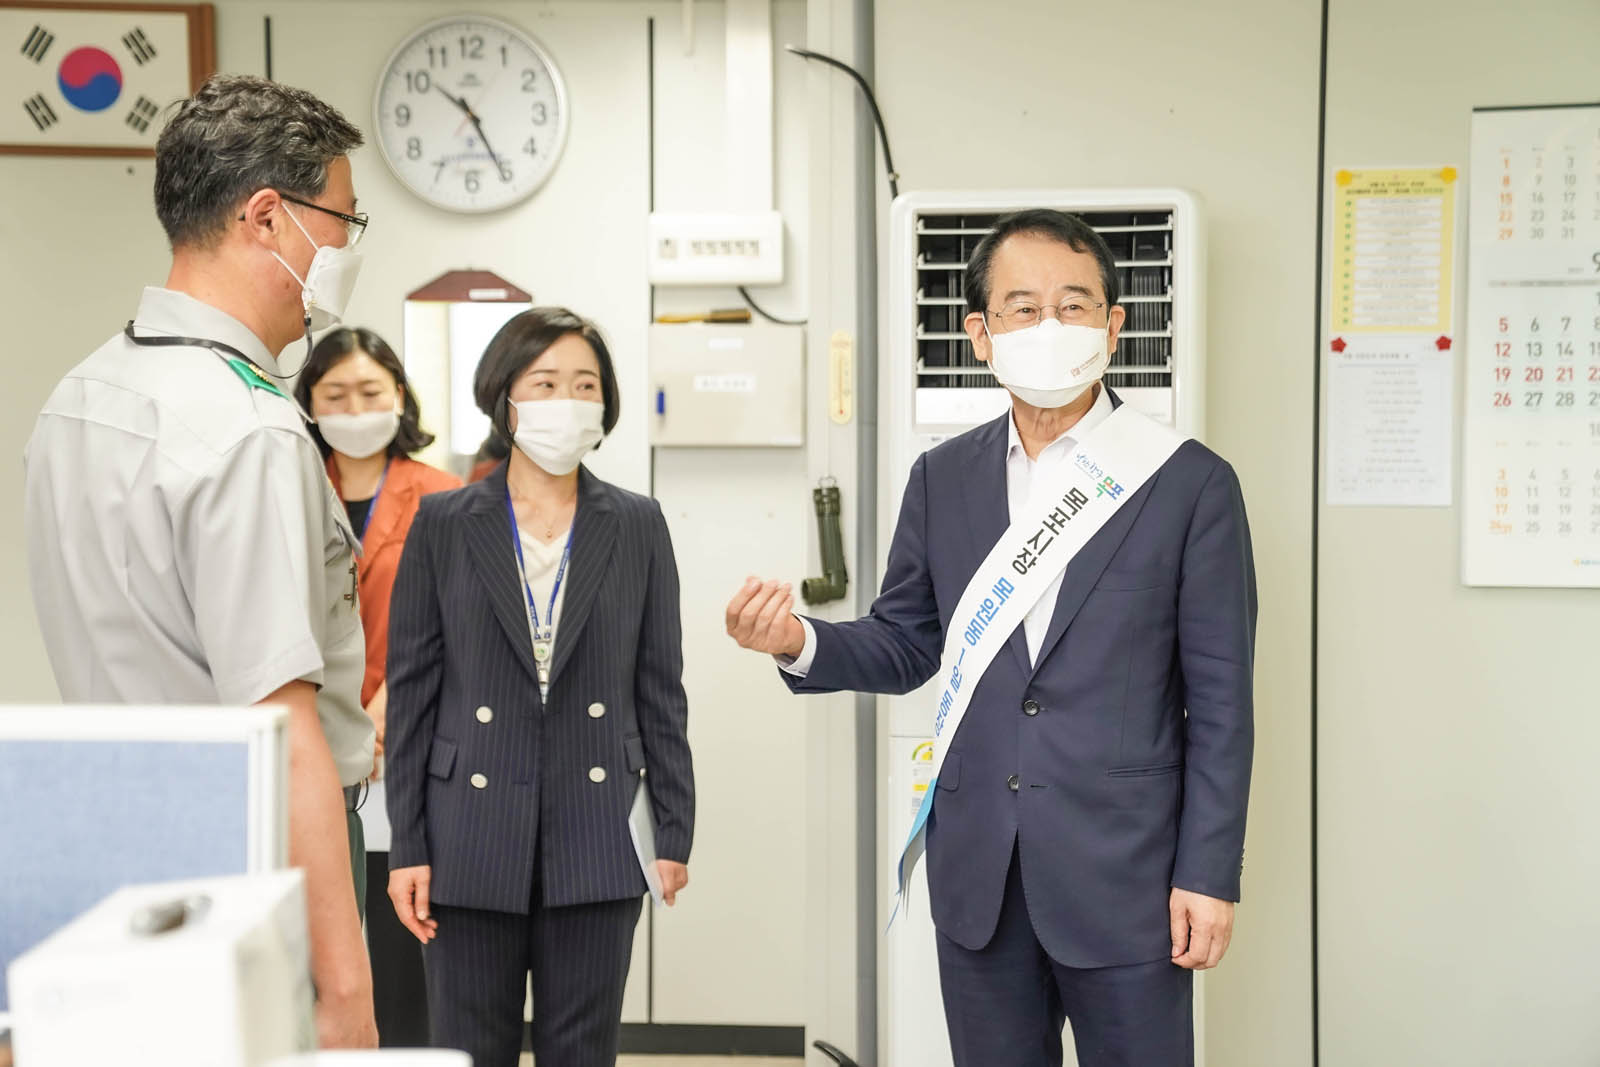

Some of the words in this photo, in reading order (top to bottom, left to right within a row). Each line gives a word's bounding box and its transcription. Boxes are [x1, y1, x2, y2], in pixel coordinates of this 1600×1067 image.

[428, 46, 447, 69] 11
[459, 35, 484, 60] 12
[500, 45, 507, 68] 1
[406, 70, 431, 94] 10
[521, 69, 536, 93] 2
[395, 103, 411, 128] 9
[532, 101, 547, 126] 3
[407, 137, 422, 161] 8
[522, 136, 537, 157] 4
[432, 160, 446, 184] 7
[465, 169, 480, 193] 6
[1563, 192, 1576, 204] 17
[1499, 316, 1509, 332] 5
[1530, 316, 1540, 332] 6
[1560, 316, 1571, 331] 7
[1494, 341, 1511, 357] 12
[1526, 341, 1543, 357] 13
[1557, 341, 1574, 357] 14
[1494, 366, 1511, 382] 19
[1524, 366, 1543, 382] 20
[1556, 366, 1573, 382] 21
[1493, 391, 1512, 407] 26
[1524, 391, 1543, 407] 27
[1555, 391, 1574, 407] 28
[1096, 476, 1124, 500] 목포
[1527, 485, 1538, 497] 11
[1012, 487, 1089, 575] 목포시장
[964, 577, 1015, 646] 목원동
